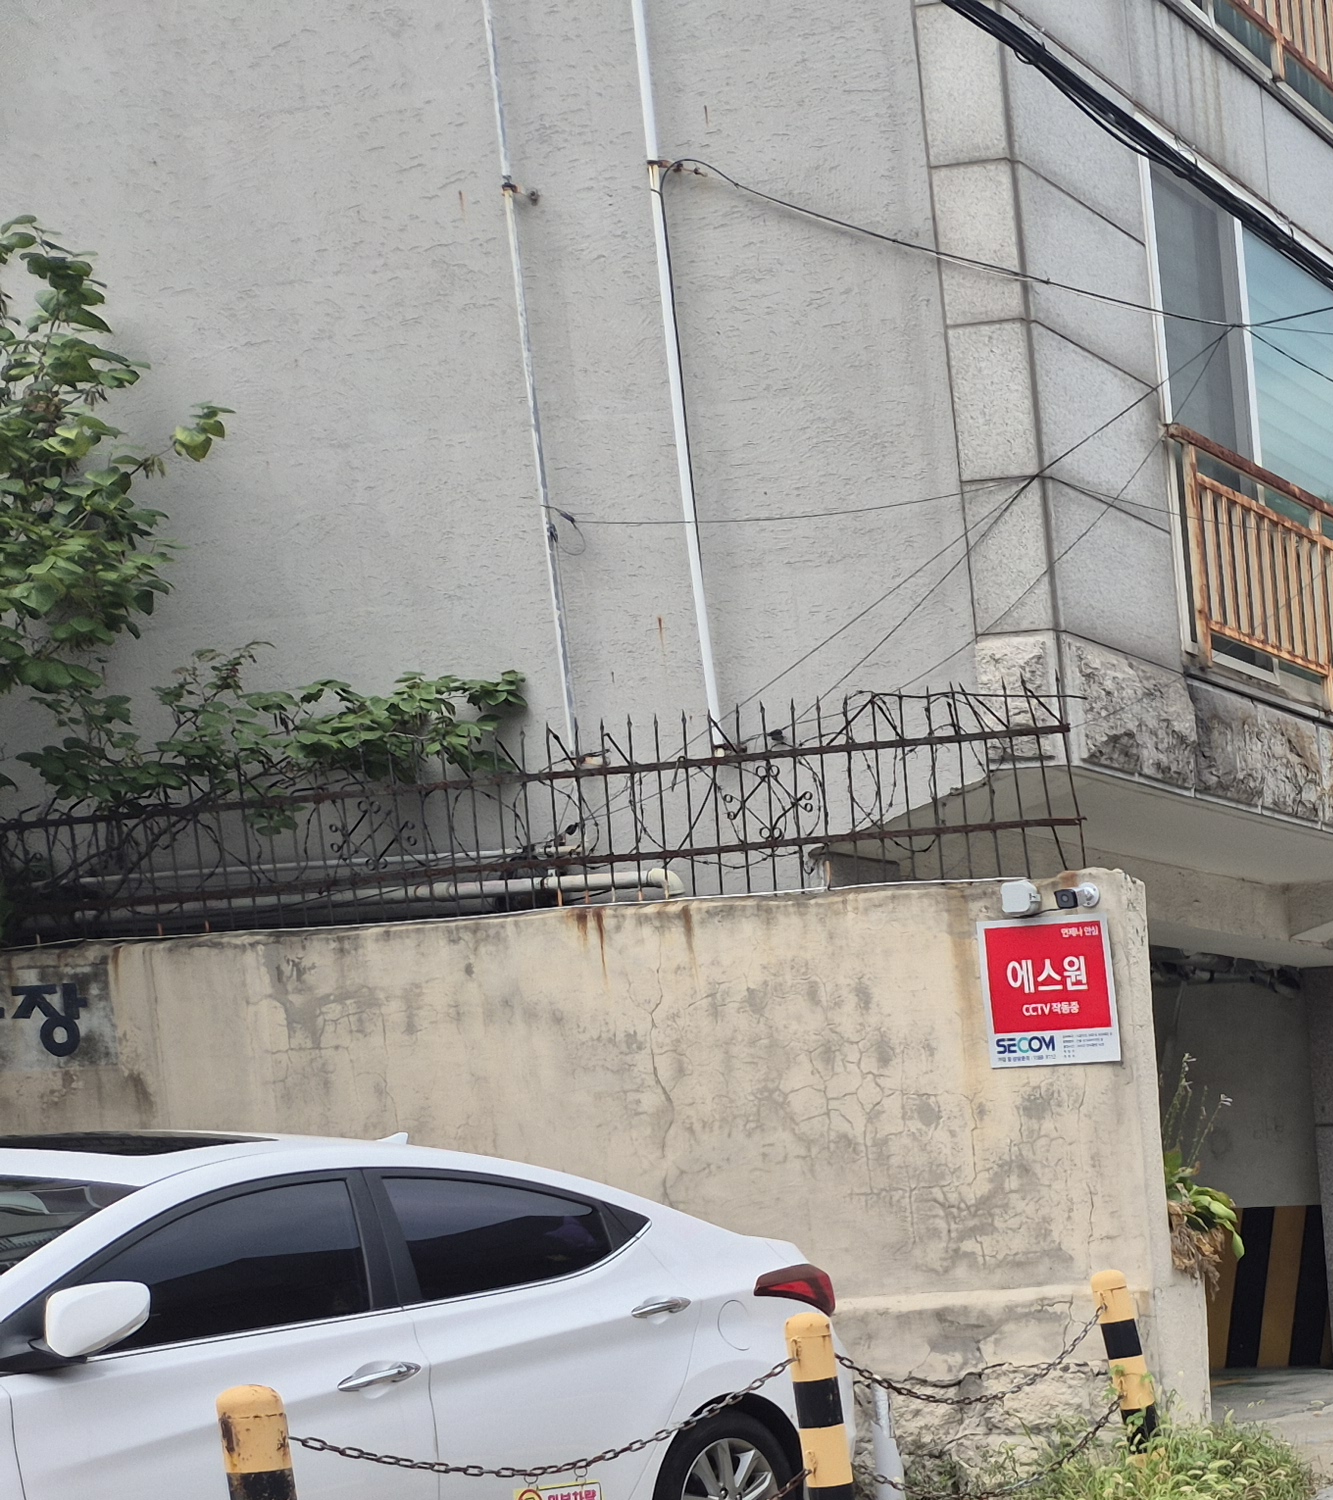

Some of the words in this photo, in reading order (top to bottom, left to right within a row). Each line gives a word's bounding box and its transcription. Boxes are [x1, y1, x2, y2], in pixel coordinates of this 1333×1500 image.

[1006, 956, 1088, 994] 에스원
[1022, 1003, 1050, 1017] CCTV
[1052, 1001, 1080, 1015] 작동중
[996, 1036, 1056, 1054] SECOM
